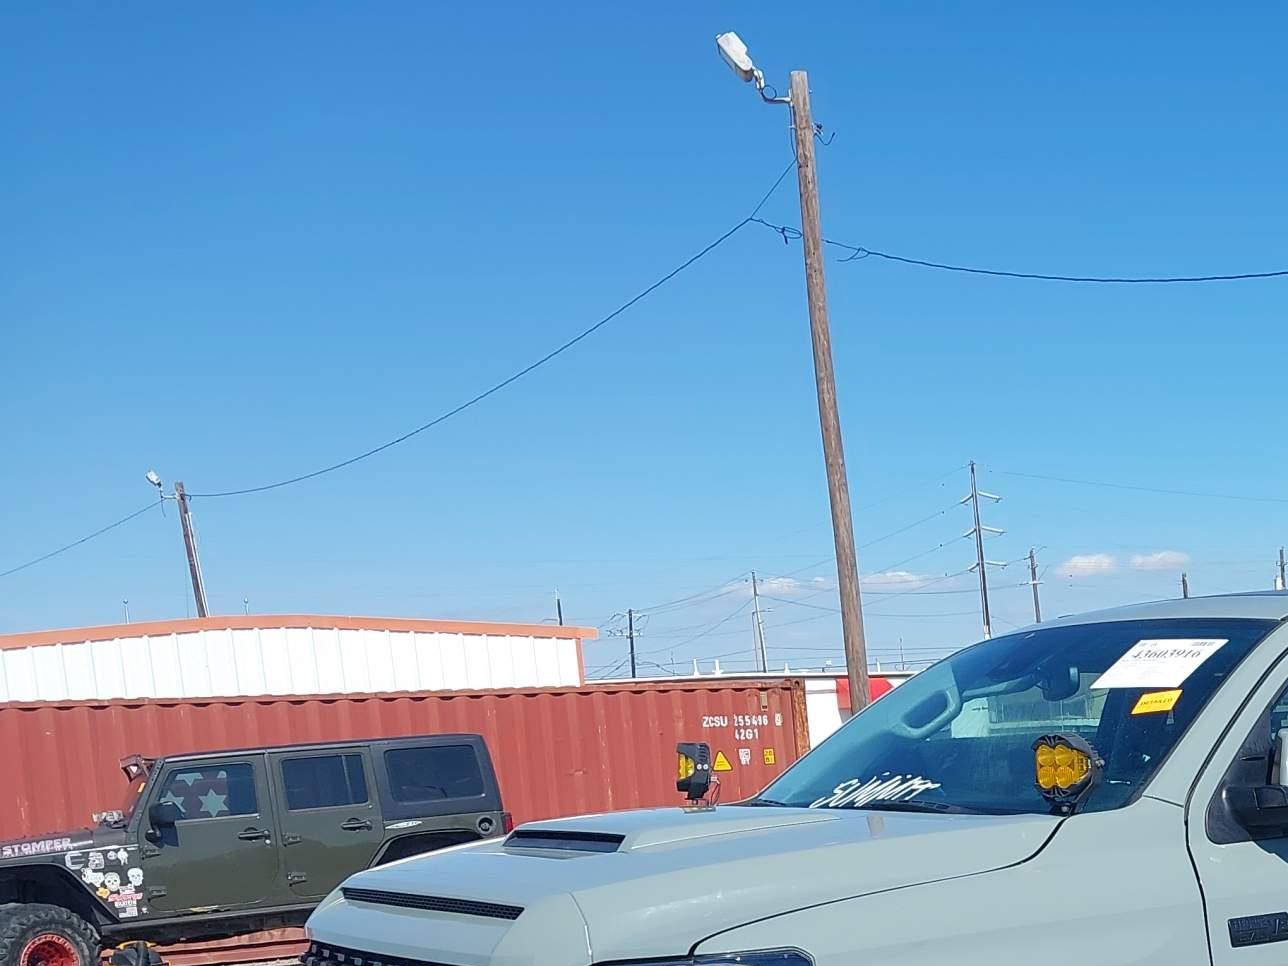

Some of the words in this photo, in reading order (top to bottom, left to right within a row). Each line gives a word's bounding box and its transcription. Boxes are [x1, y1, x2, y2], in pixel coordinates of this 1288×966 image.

[702, 715, 729, 728] ZCSU
[735, 728, 759, 740] 42G1
[2, 837, 74, 859] STOMPER
